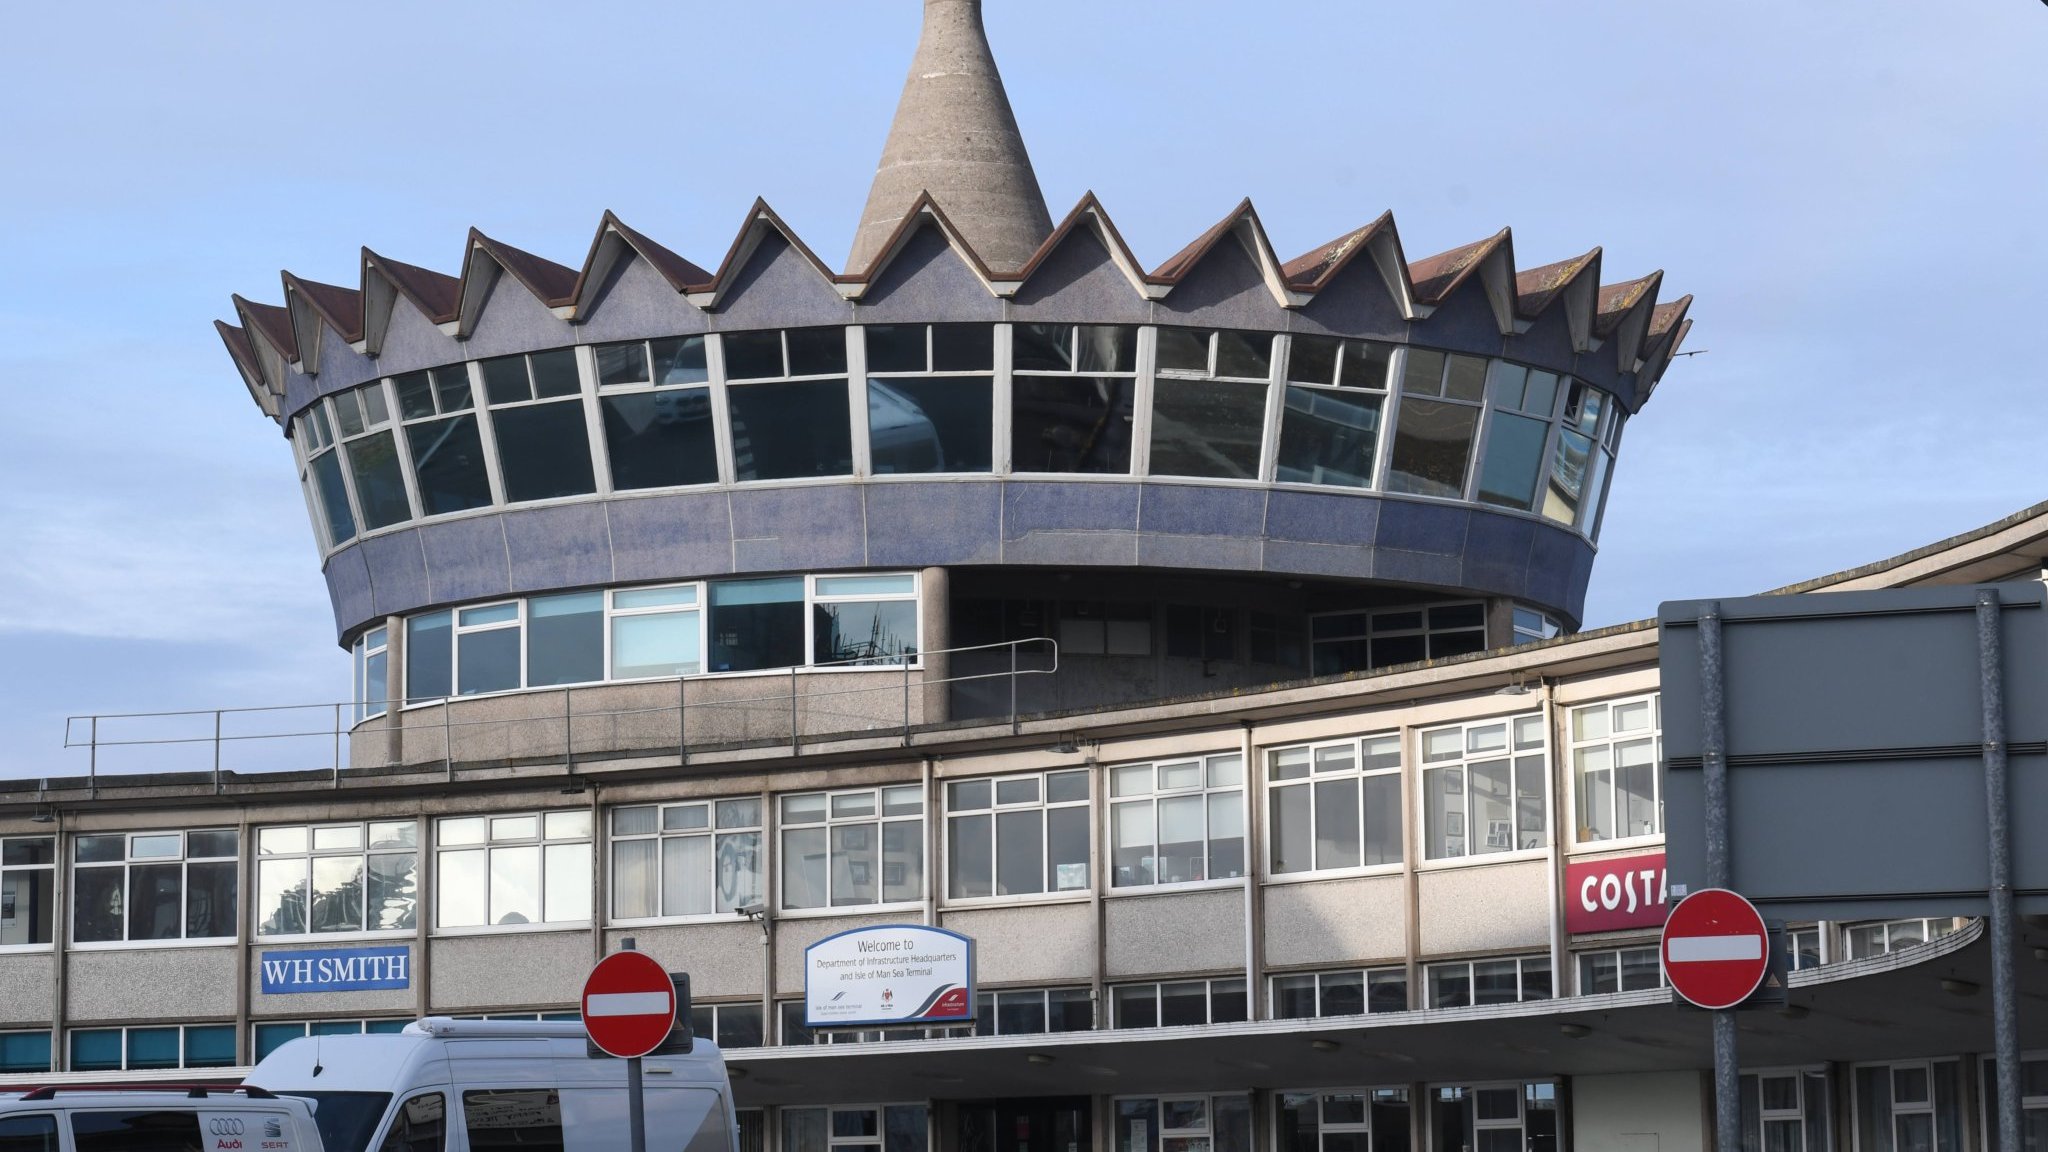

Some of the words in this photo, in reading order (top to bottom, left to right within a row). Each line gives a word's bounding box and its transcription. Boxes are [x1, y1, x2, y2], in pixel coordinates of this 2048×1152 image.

[858, 940, 900, 952] Welcome
[904, 939, 914, 950] to
[817, 959, 857, 969] Department
[858, 957, 865, 966] of
[867, 955, 909, 965] Infrastructure
[911, 953, 957, 964] Headquarters
[840, 972, 853, 980] and
[854, 971, 866, 980] Isle
[867, 970, 875, 979] of
[876, 970, 890, 978] Man
[892, 969, 904, 977] Sea
[906, 967, 933, 977] Terminal
[217, 1139, 243, 1149] Audi
[261, 1141, 289, 1149] SEAT
